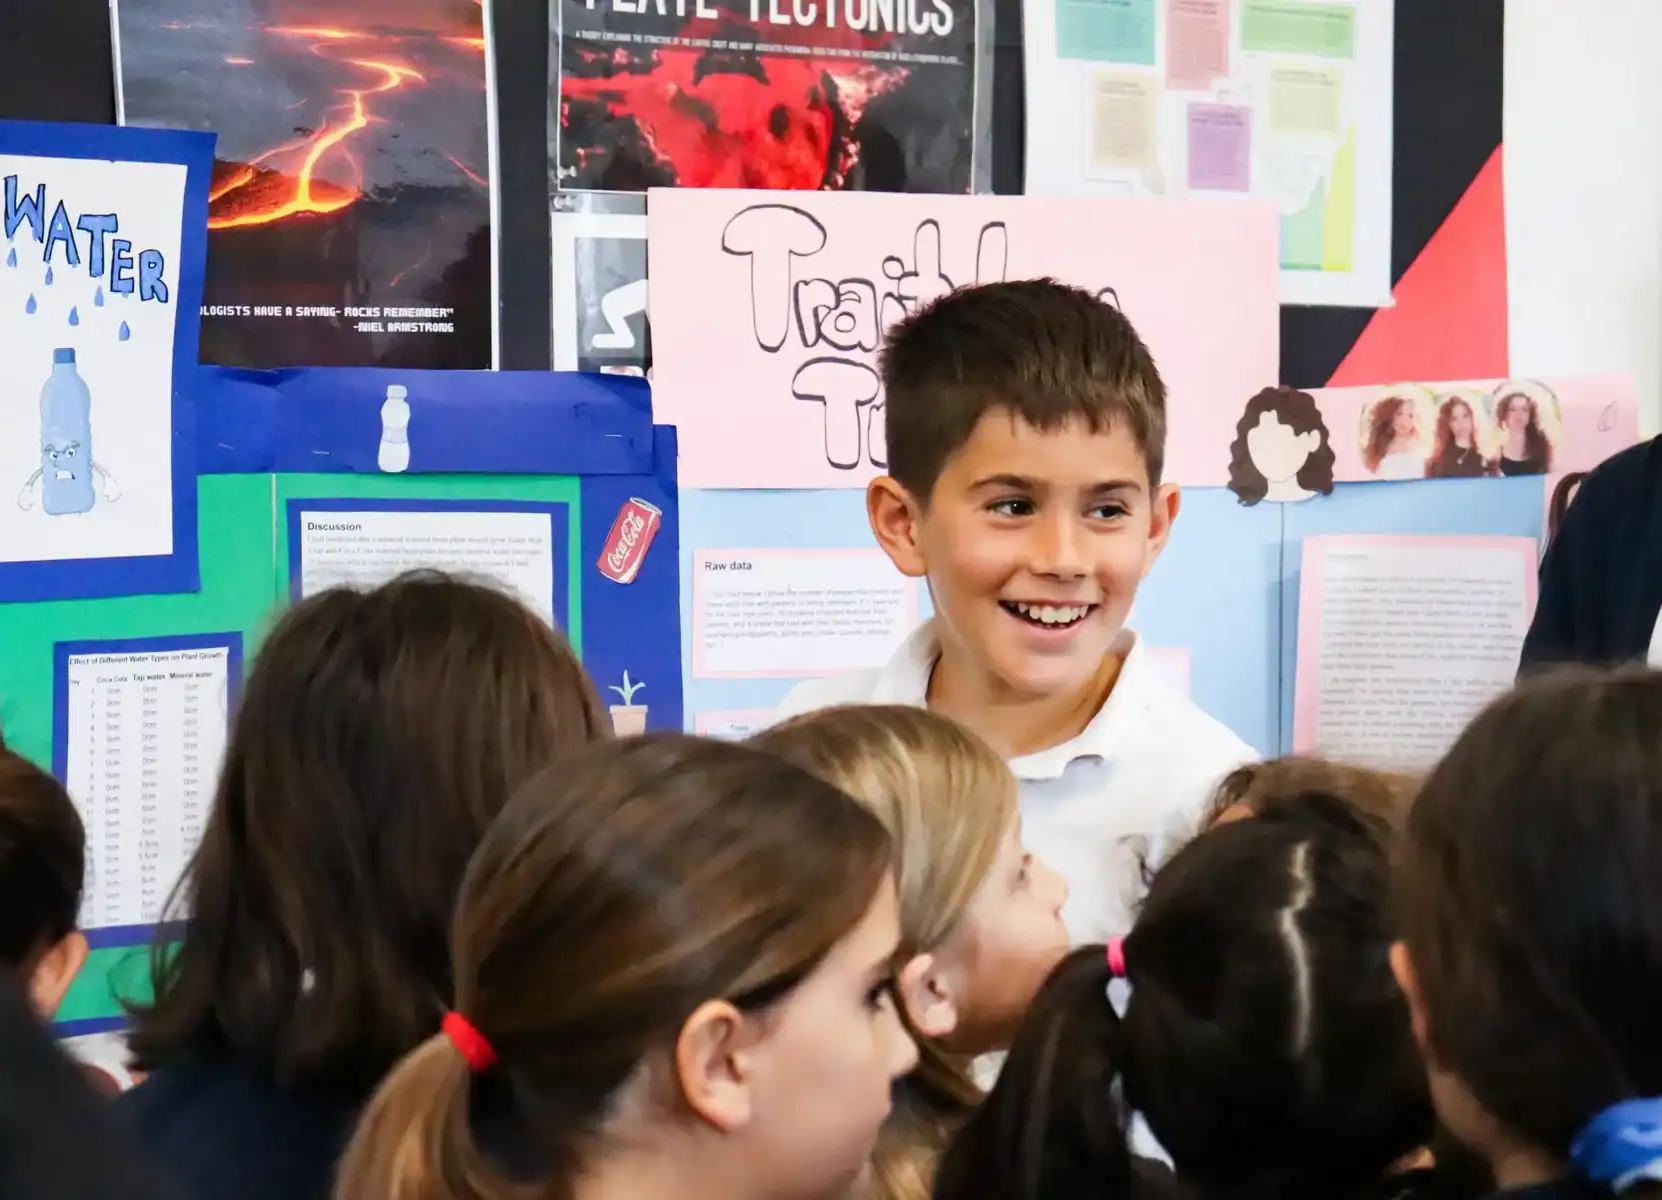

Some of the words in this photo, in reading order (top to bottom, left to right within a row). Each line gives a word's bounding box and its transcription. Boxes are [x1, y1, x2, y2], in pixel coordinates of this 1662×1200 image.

[4, 174, 169, 303] WATER
[254, 306, 282, 317] HAVE
[285, 306, 292, 317] A
[344, 307, 380, 317] ROCKS
[387, 322, 454, 333] ARMSTRONG
[307, 522, 362, 531] Discussion
[705, 561, 727, 571] Raw
[730, 561, 753, 571] data
[99, 656, 128, 664] Different
[130, 655, 149, 663] Water
[151, 655, 170, 663] Types
[97, 676, 112, 684] Coca
[133, 674, 145, 682] Tap
[170, 671, 194, 679] Mineral
